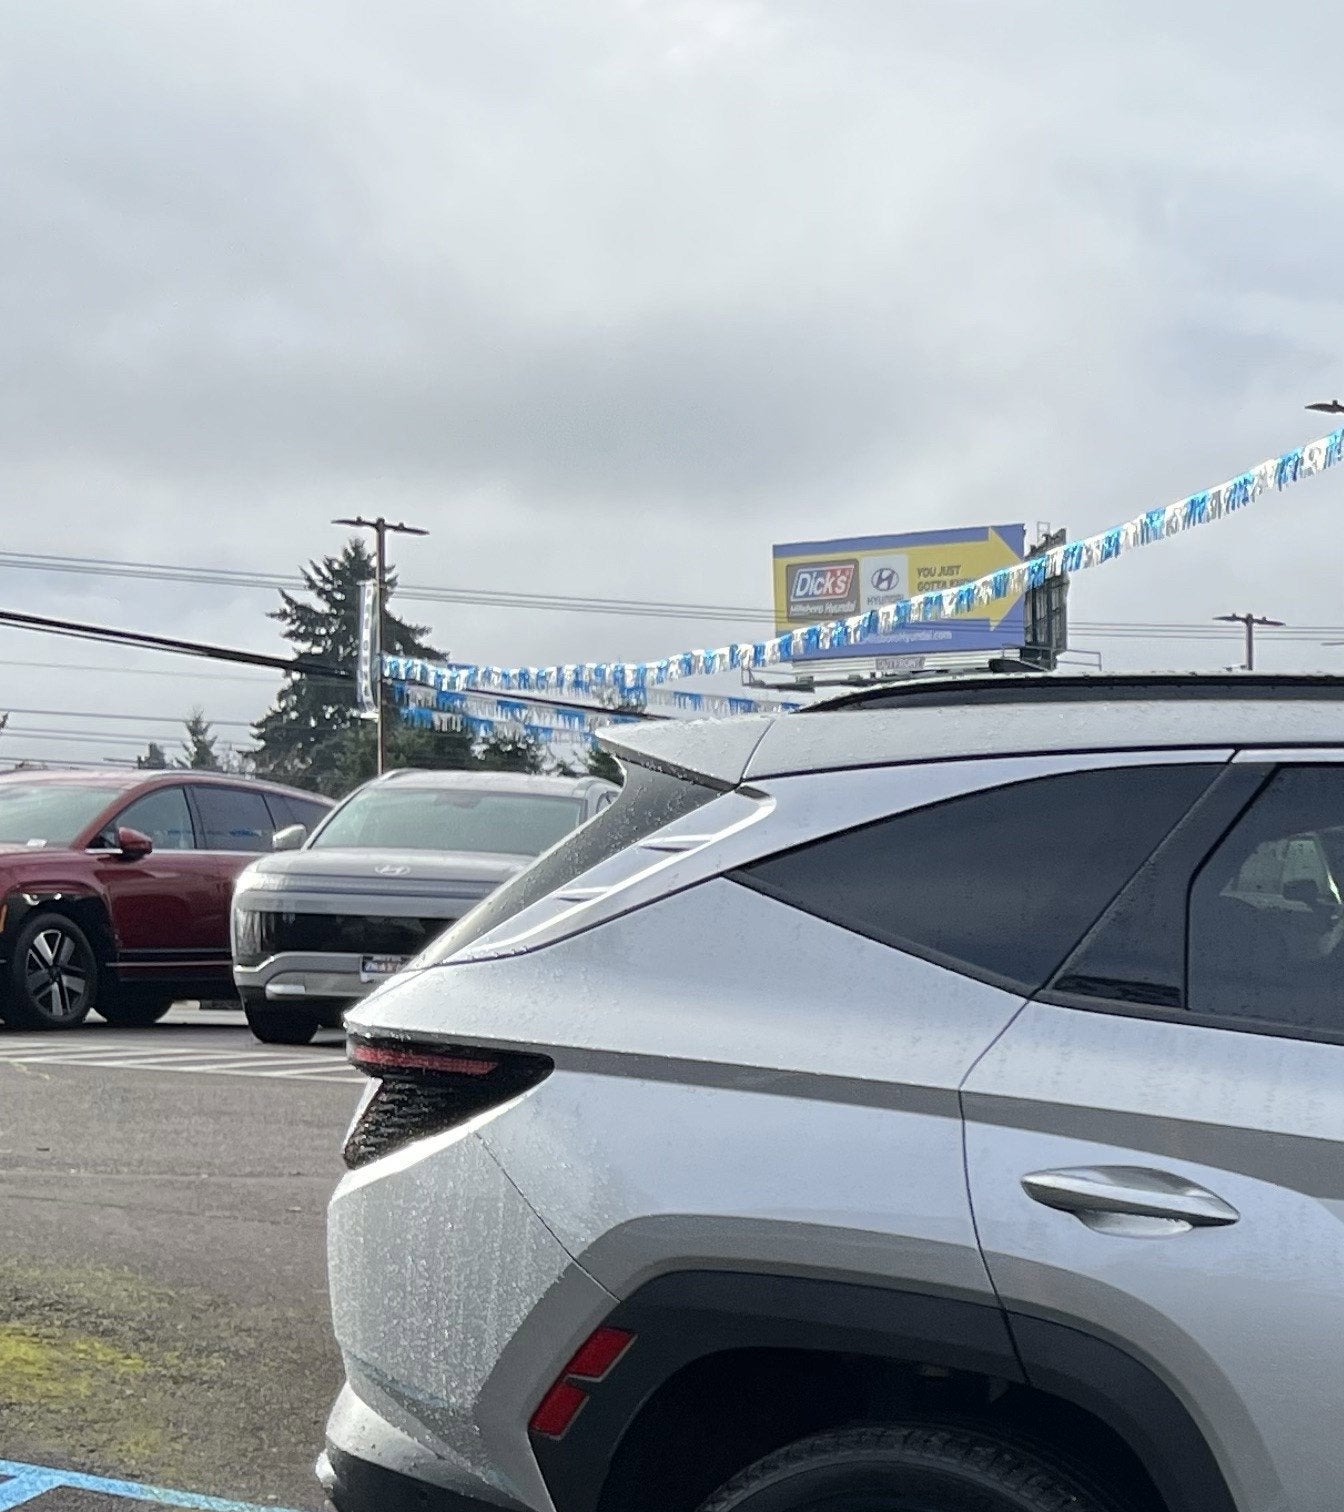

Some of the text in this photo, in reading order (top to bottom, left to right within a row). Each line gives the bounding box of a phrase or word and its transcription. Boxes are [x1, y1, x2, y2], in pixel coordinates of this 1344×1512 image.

[916, 564, 962, 579] YOU JUST
[796, 569, 849, 596] Dick's
